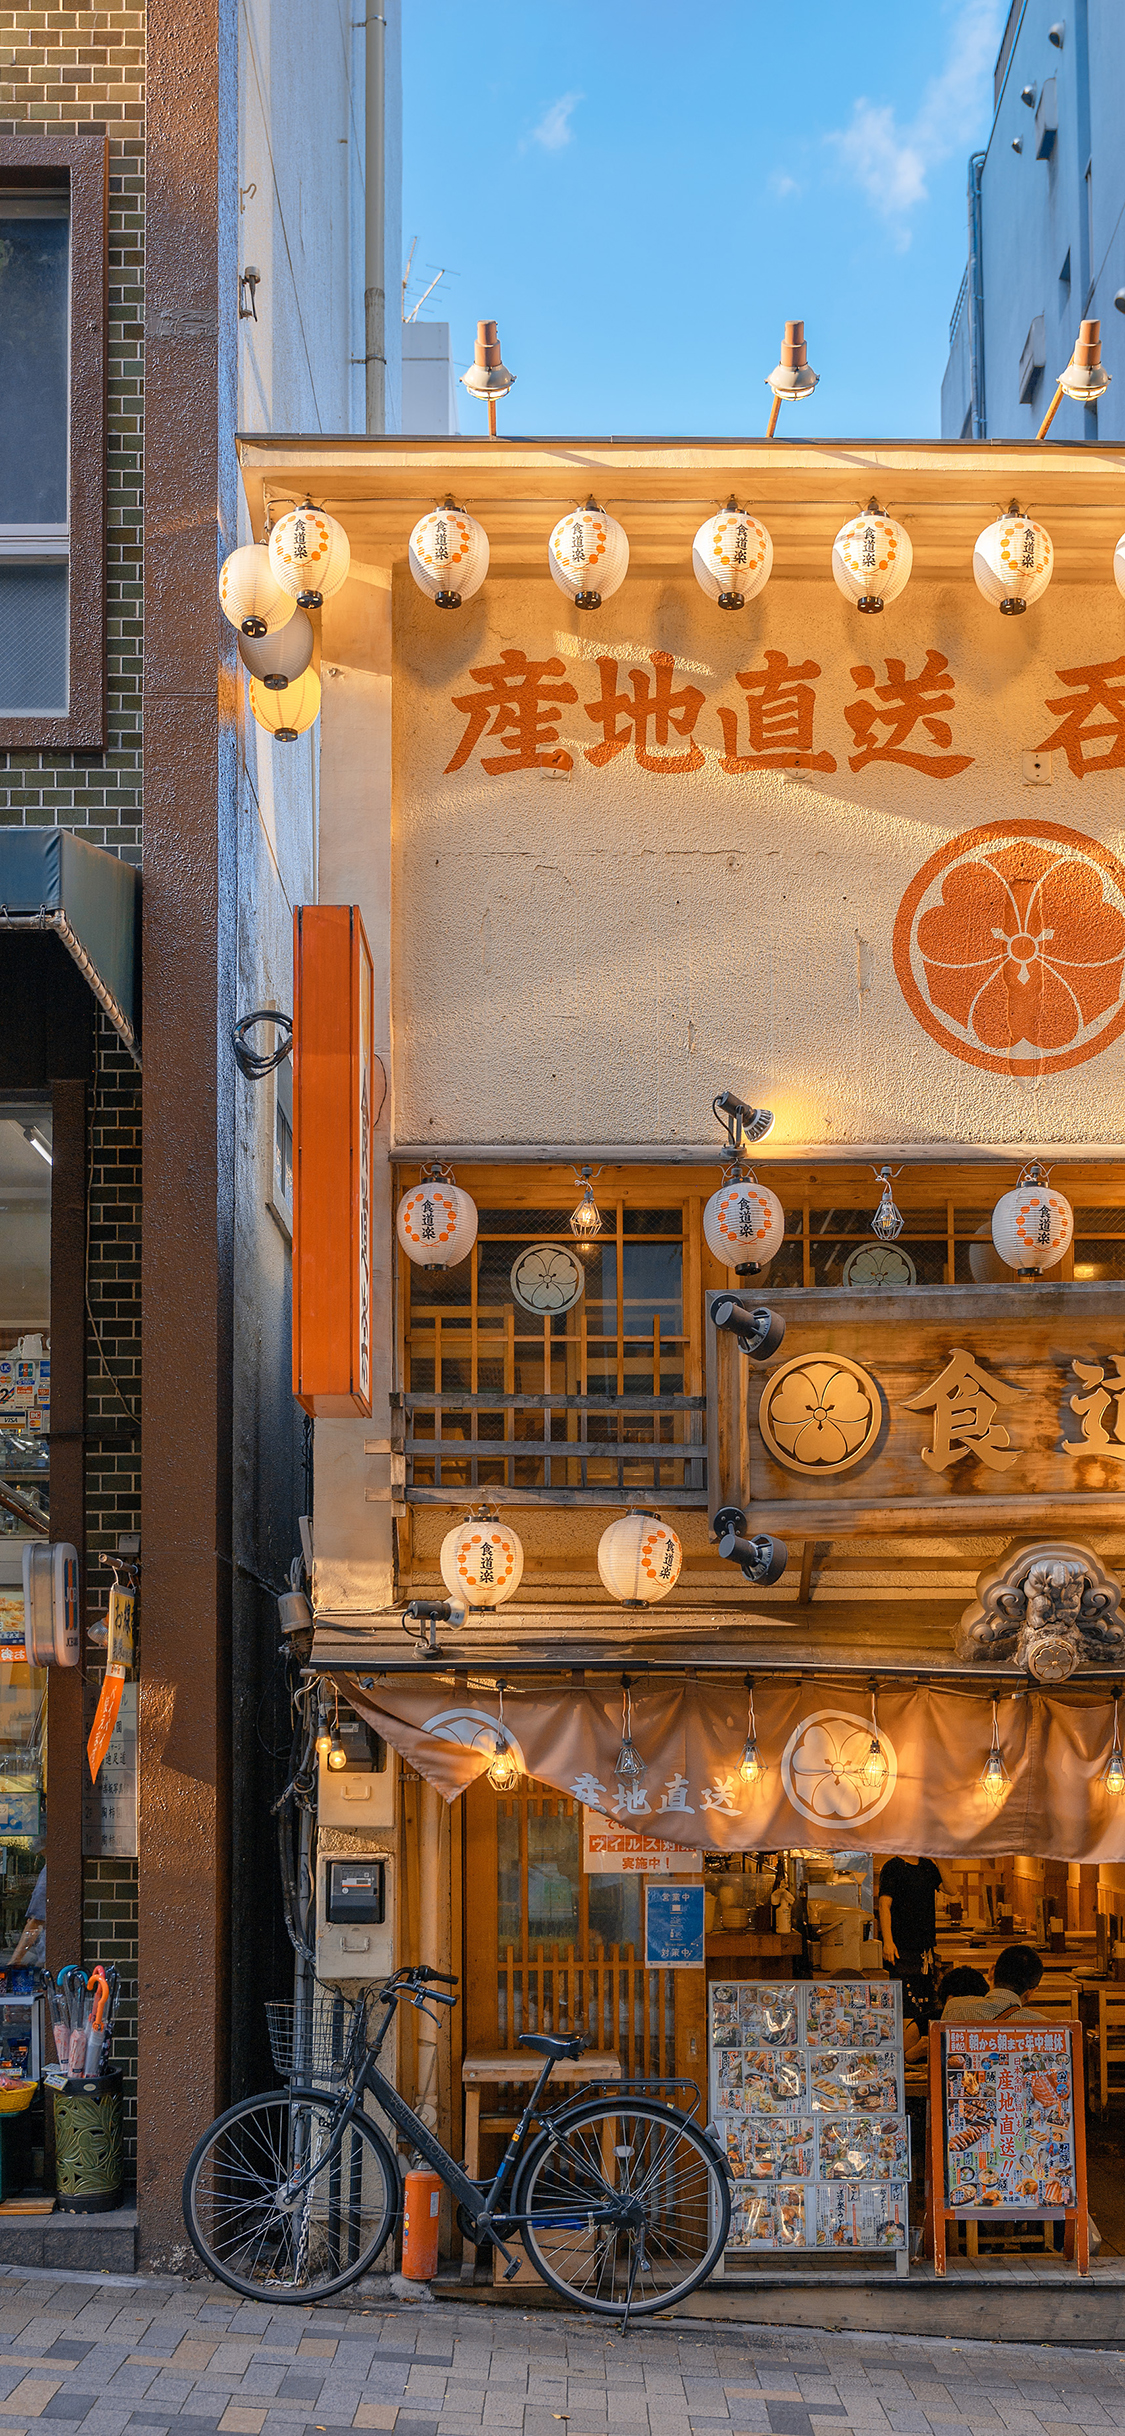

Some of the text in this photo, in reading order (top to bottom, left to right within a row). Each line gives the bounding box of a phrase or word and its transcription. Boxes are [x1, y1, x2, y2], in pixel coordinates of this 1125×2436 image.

[294, 518, 307, 560] 食道楽
[435, 519, 449, 561] 食道楽
[572, 521, 586, 562] 食道楽
[734, 523, 748, 565] 食道楽
[862, 526, 876, 568] 食道楽
[1022, 528, 1035, 569] 食道楽
[443, 649, 975, 779] 産地直送
[421, 1198, 436, 1241] 食道楽
[737, 1197, 754, 1239] 食道楽
[1037, 1204, 1051, 1246] 食道楽
[479, 1541, 495, 1585] 食道楽
[658, 1538, 675, 1581] 食道楽
[65, 1586, 77, 1602] JCB
[569, 1772, 743, 1817] 産地直送
[592, 1838, 695, 1851] ウイルス対
[662, 1892, 690, 1902] 営業中
[661, 1948, 690, 1958] 対策中
[969, 2033, 1064, 2052] 朝から朝まで年中無休
[390, 2093, 461, 2181] VOITURE VOYAGE
